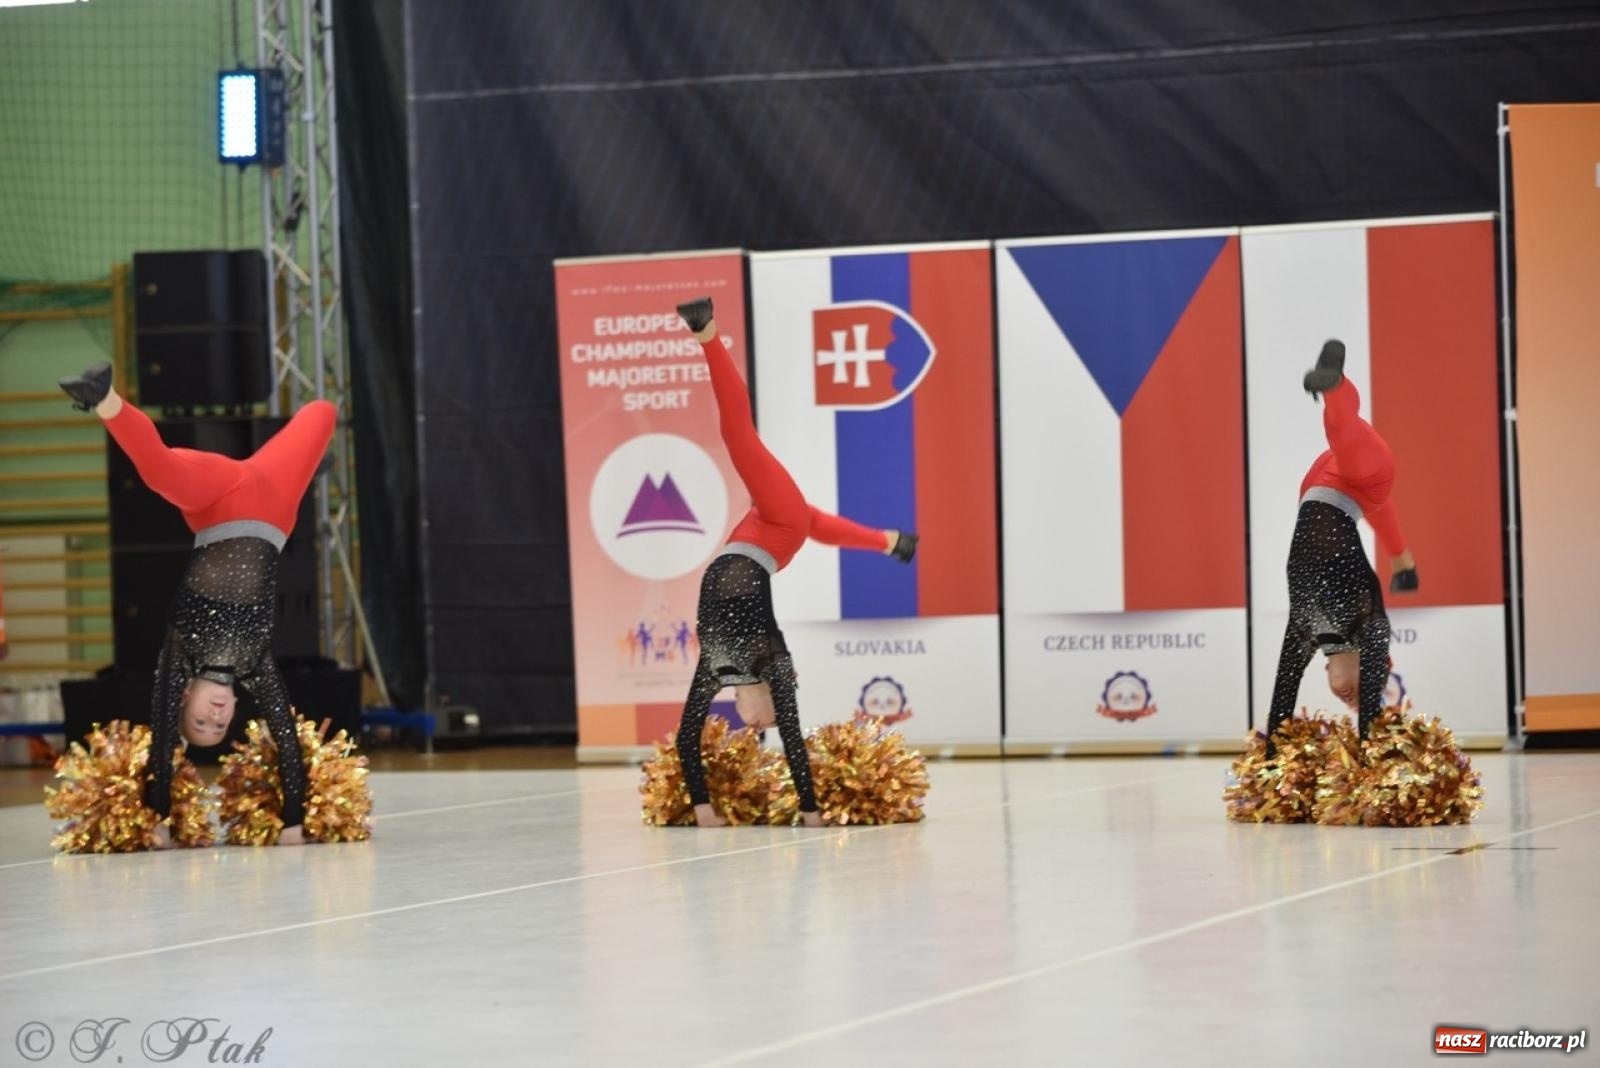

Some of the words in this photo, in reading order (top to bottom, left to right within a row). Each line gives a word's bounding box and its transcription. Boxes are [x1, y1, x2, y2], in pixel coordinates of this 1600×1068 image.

[594, 312, 692, 335] EUROPEA
[571, 335, 733, 363] CHAMPIONSP
[587, 364, 711, 389] MAJORETTE
[623, 390, 691, 411] SPORT
[834, 639, 927, 657] SLOVAKIA
[1043, 633, 1106, 651] CZECH
[1111, 631, 1207, 650] REPUBLIC
